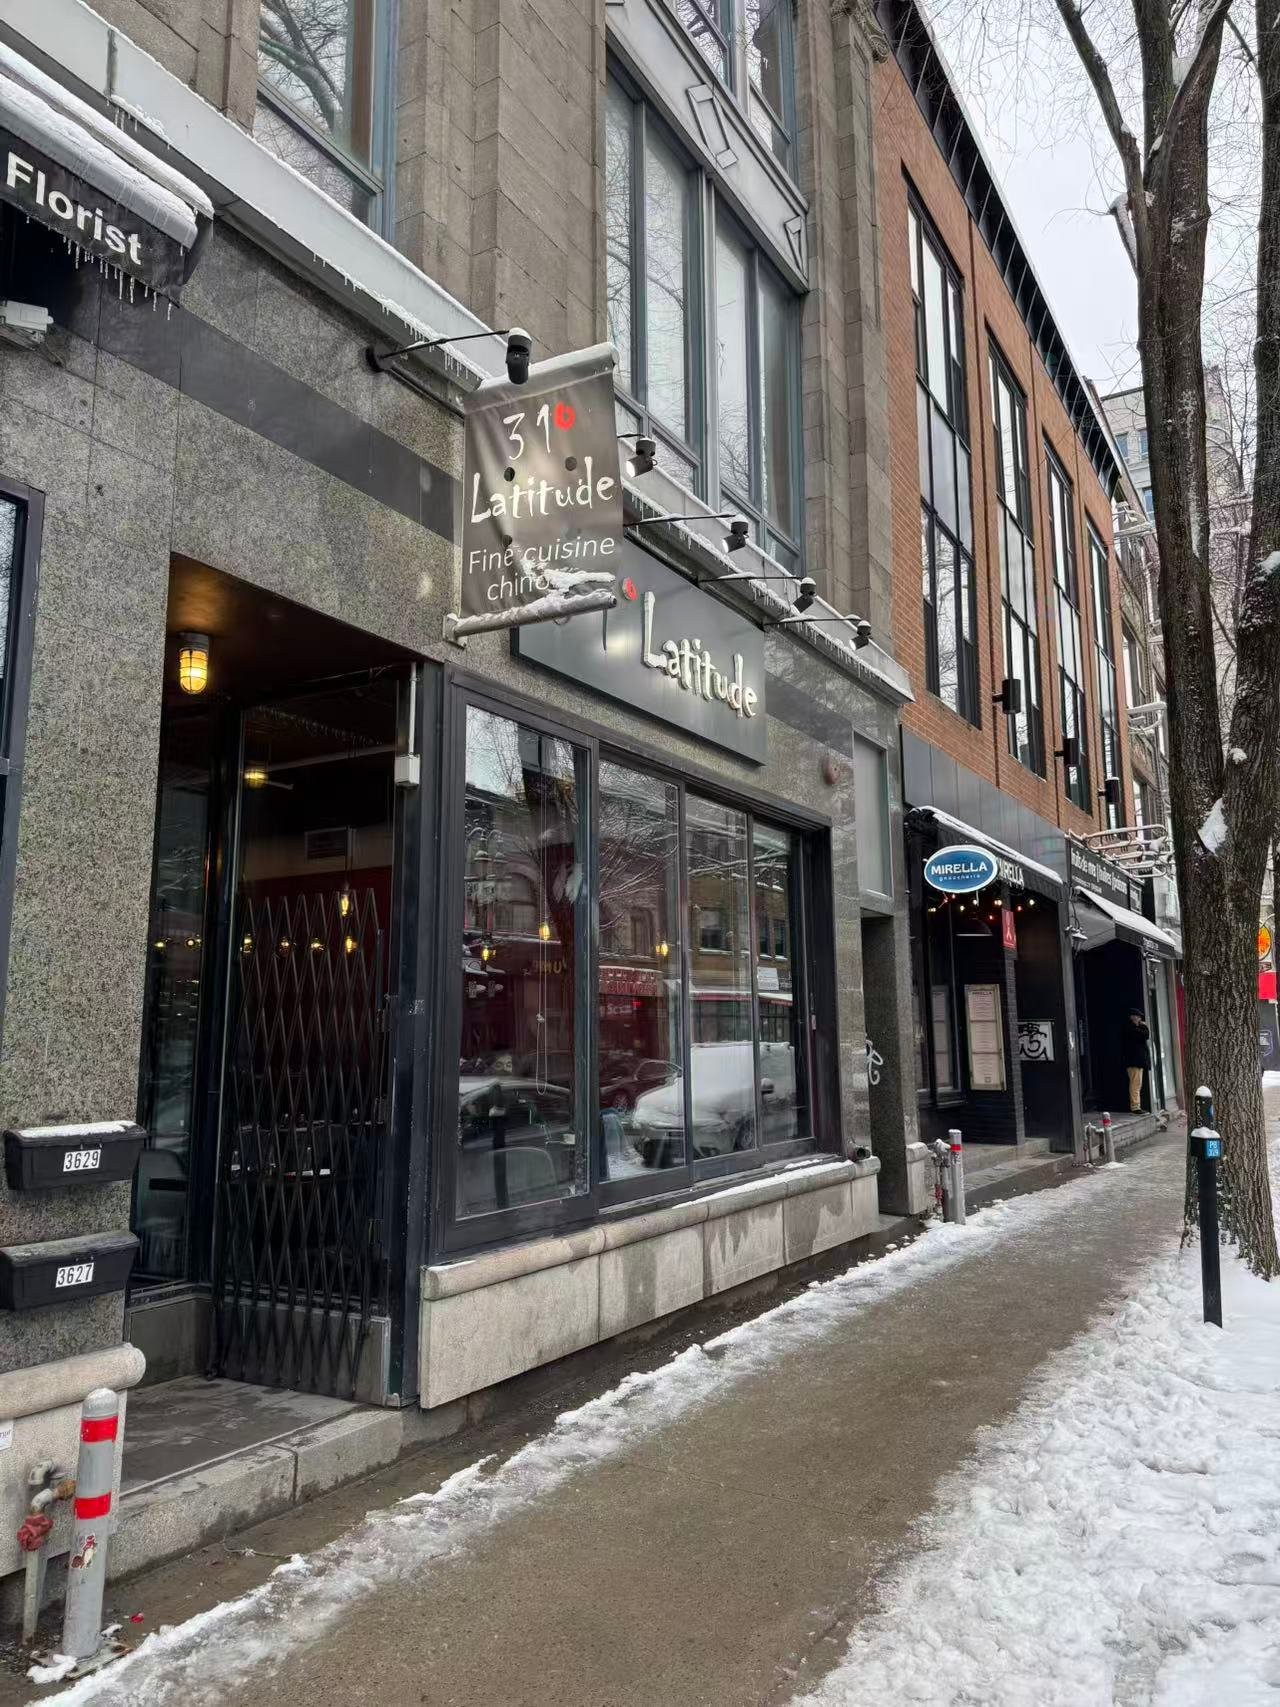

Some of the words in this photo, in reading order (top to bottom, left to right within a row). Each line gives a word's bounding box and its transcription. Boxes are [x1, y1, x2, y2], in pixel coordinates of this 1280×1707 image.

[6, 151, 142, 266] Florist
[471, 456, 615, 524] Latitude
[469, 548, 514, 574] Fine
[523, 536, 615, 562] cuisine
[487, 572, 550, 601] chino
[643, 591, 758, 718] Latitude
[931, 861, 988, 875] MIRELLA
[65, 1151, 99, 1169] 3629
[57, 1264, 92, 1285] 3627
